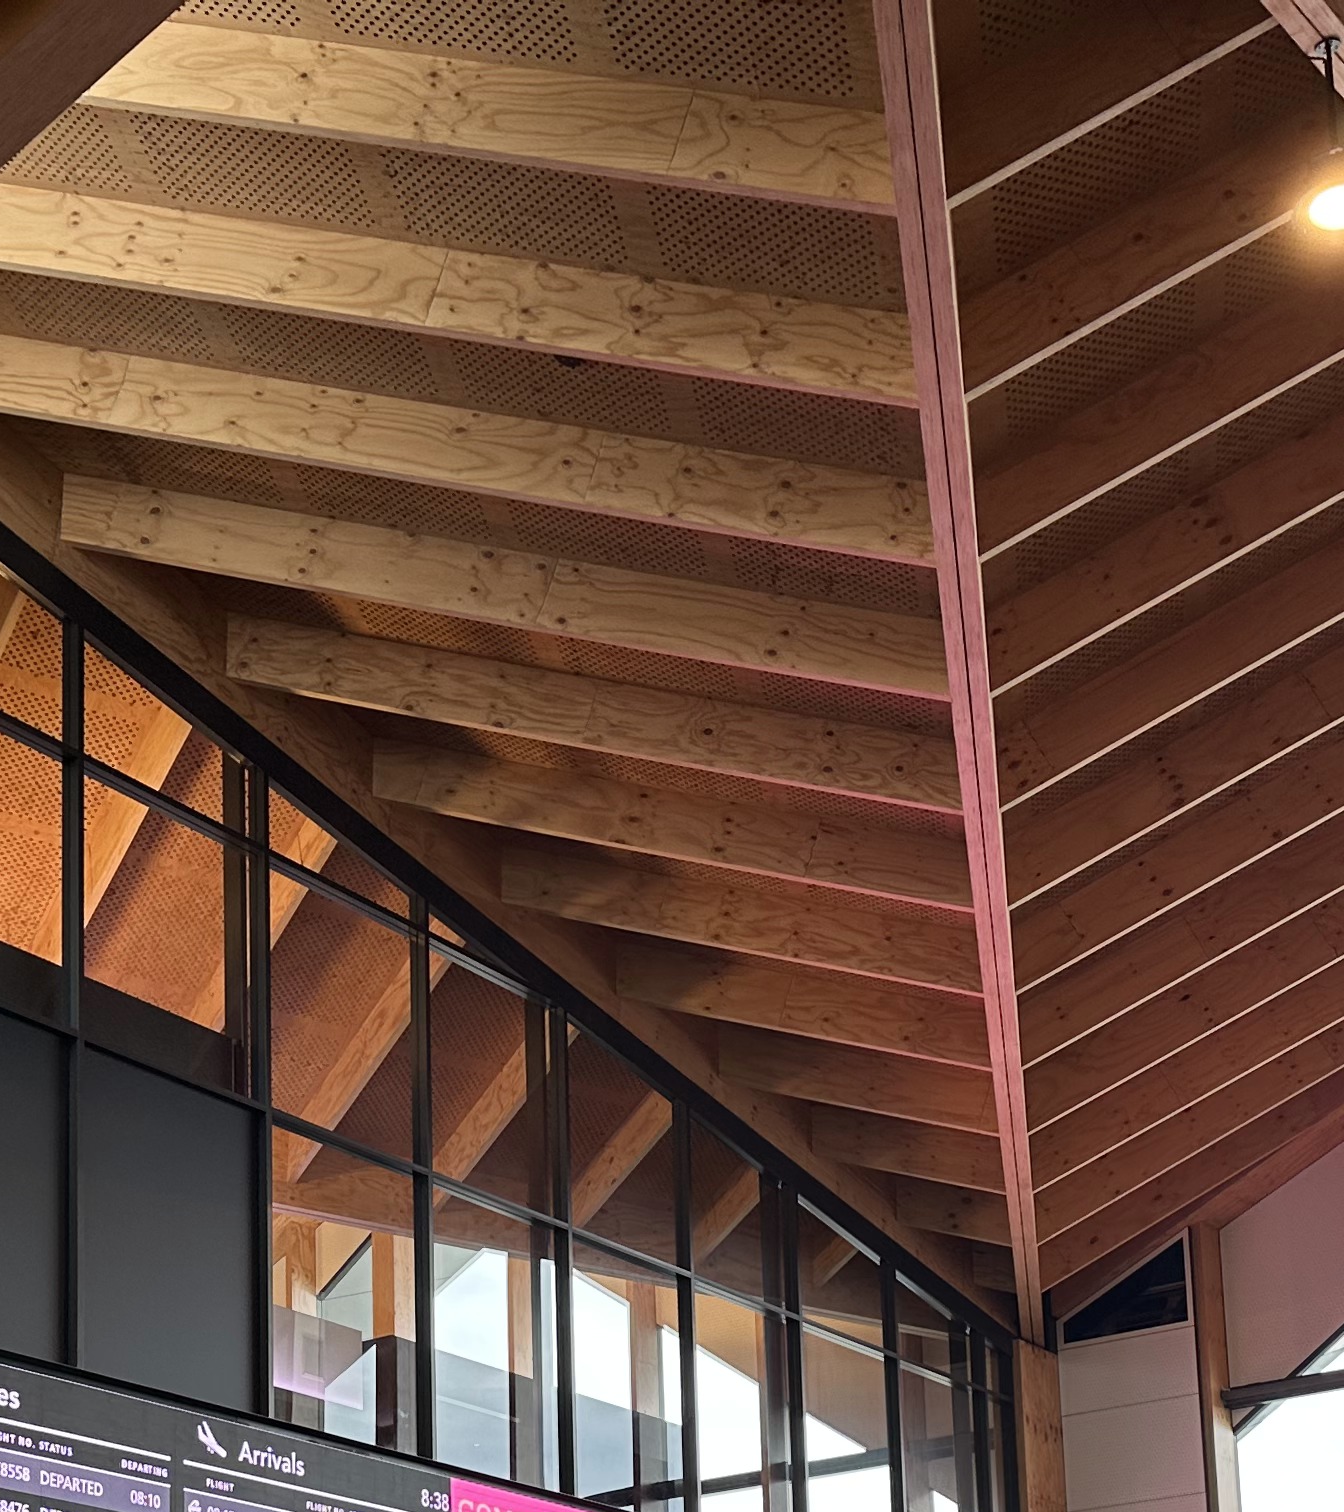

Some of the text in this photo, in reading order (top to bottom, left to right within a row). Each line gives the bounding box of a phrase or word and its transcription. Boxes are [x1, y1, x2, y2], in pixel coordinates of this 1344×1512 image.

[18, 1436, 35, 1449] NO.
[39, 1441, 74, 1457] STATUS
[121, 1459, 168, 1478] DEPARTING
[238, 1441, 305, 1476] Arrivals
[40, 1471, 104, 1496] DEPARTED
[130, 1490, 161, 1509] 08:10
[206, 1478, 234, 1492] FLIGHT
[420, 1489, 449, 1511] 8:38
